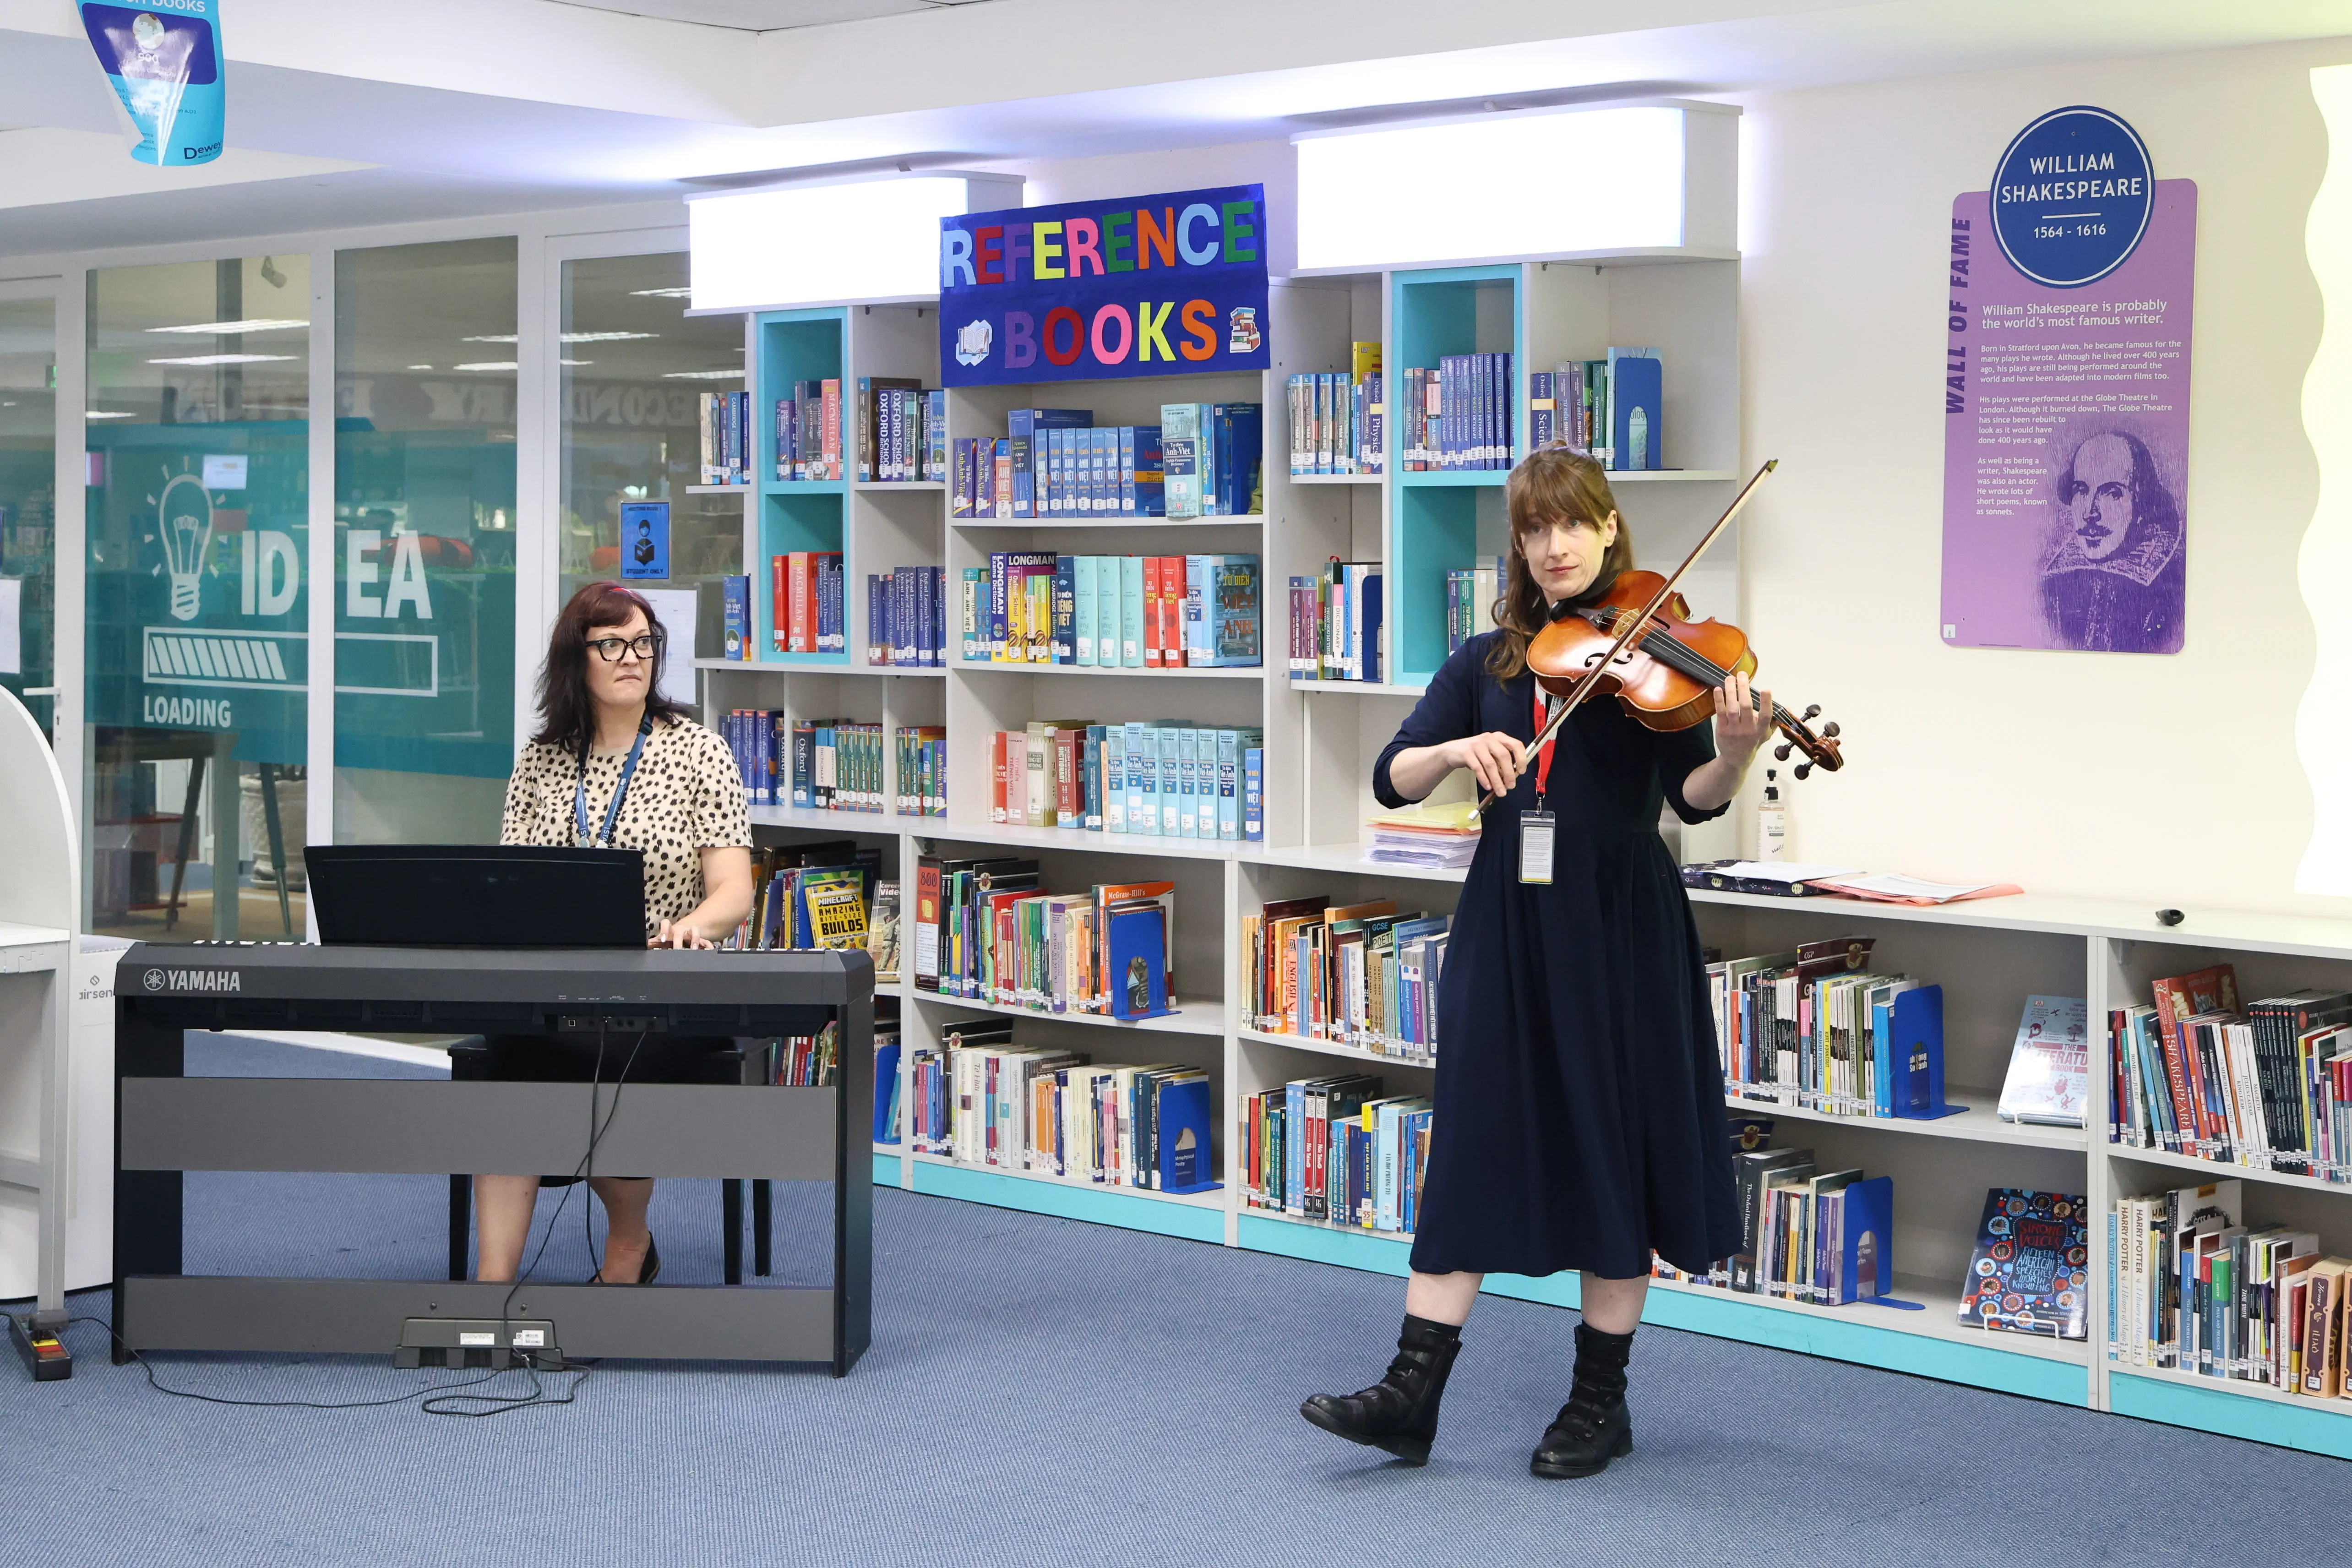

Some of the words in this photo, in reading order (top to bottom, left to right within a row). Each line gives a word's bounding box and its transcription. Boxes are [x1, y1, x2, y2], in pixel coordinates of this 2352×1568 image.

[184, 140, 222, 159] Dewey
[2030, 152, 2114, 174] WILLIAM
[2002, 177, 2142, 203] SHAKESPEARE
[2034, 226, 2063, 238] 1564
[2077, 223, 2106, 236] 1616
[941, 200, 1256, 287] REFERENCE
[1950, 218, 1970, 288] FAME
[1982, 305, 2023, 316] William
[2027, 303, 2098, 317] Shakespeare
[2102, 301, 2111, 311] is
[2115, 299, 2167, 315] probably
[1949, 300, 1967, 332] OF
[1982, 319, 2000, 328] the
[2004, 316, 2044, 328] world's
[2048, 314, 2075, 327] most
[2079, 314, 2120, 326] famous
[2124, 311, 2163, 324] writer.
[1005, 299, 1217, 368] BOOKS
[2058, 353, 2090, 361] Although
[2009, 365, 2027, 373] plays
[2058, 364, 2078, 372] being
[2080, 363, 2118, 372] performed
[1946, 347, 1965, 414] WALL
[2056, 374, 2084, 382] adapted
[1993, 396, 2009, 404] plays
[2032, 395, 2069, 403] performed
[880, 393, 888, 437] OXFORD
[893, 392, 901, 436] OXFORD
[2009, 406, 2040, 414] Although
[2014, 457, 2033, 465] being
[2003, 467, 2047, 476] Shakespeare
[1008, 555, 1054, 566] LONGMAN
[144, 696, 231, 728] LOADING
[920, 872, 937, 887] 800
[818, 894, 858, 906] MINECRAFT
[1108, 889, 1145, 899] McGraw-Hill's
[819, 904, 860, 916] AMAZING
[822, 918, 864, 936] BUILDS
[1372, 922, 1388, 931] GCSE
[1804, 951, 1814, 959] CGP
[168, 970, 240, 991] YAMAHA
[2167, 1040, 2190, 1128] SHAKESPEARE
[2019, 1220, 2064, 1236] STRONG
[2019, 1235, 2061, 1249] VOICES
[2023, 1247, 2054, 1258] FIFTEEN
[2016, 1255, 2055, 1271] AMERICAN
[2016, 1266, 2052, 1279] SPEECHES
[2012, 1279, 2050, 1292] KNOWING
